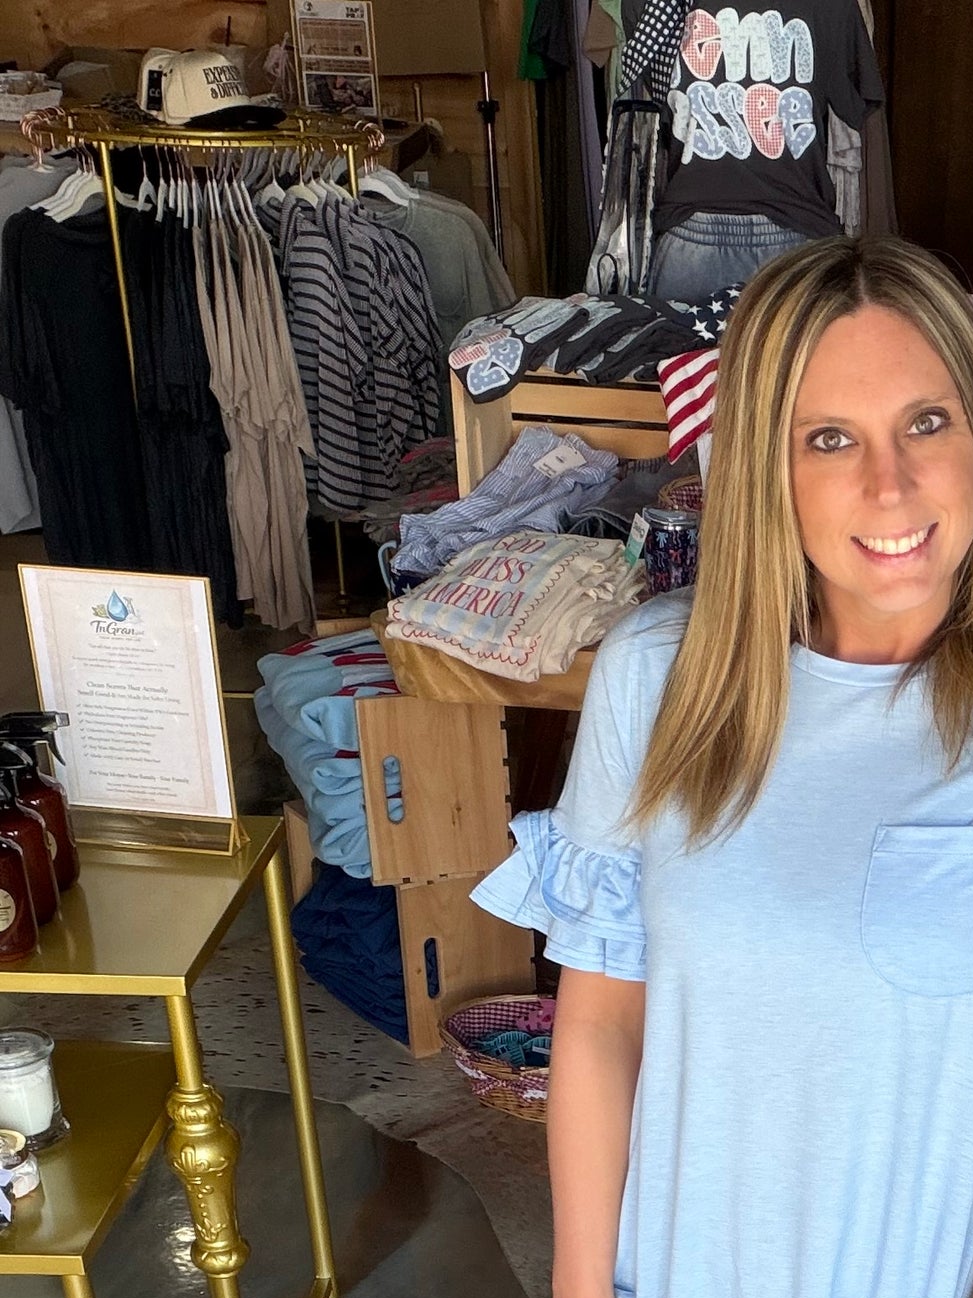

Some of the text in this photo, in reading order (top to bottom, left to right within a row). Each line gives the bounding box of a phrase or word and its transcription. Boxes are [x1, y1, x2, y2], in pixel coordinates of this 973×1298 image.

[491, 536, 546, 554] GOD
[458, 556, 536, 585] BLESS
[423, 582, 526, 619] AMERICA
